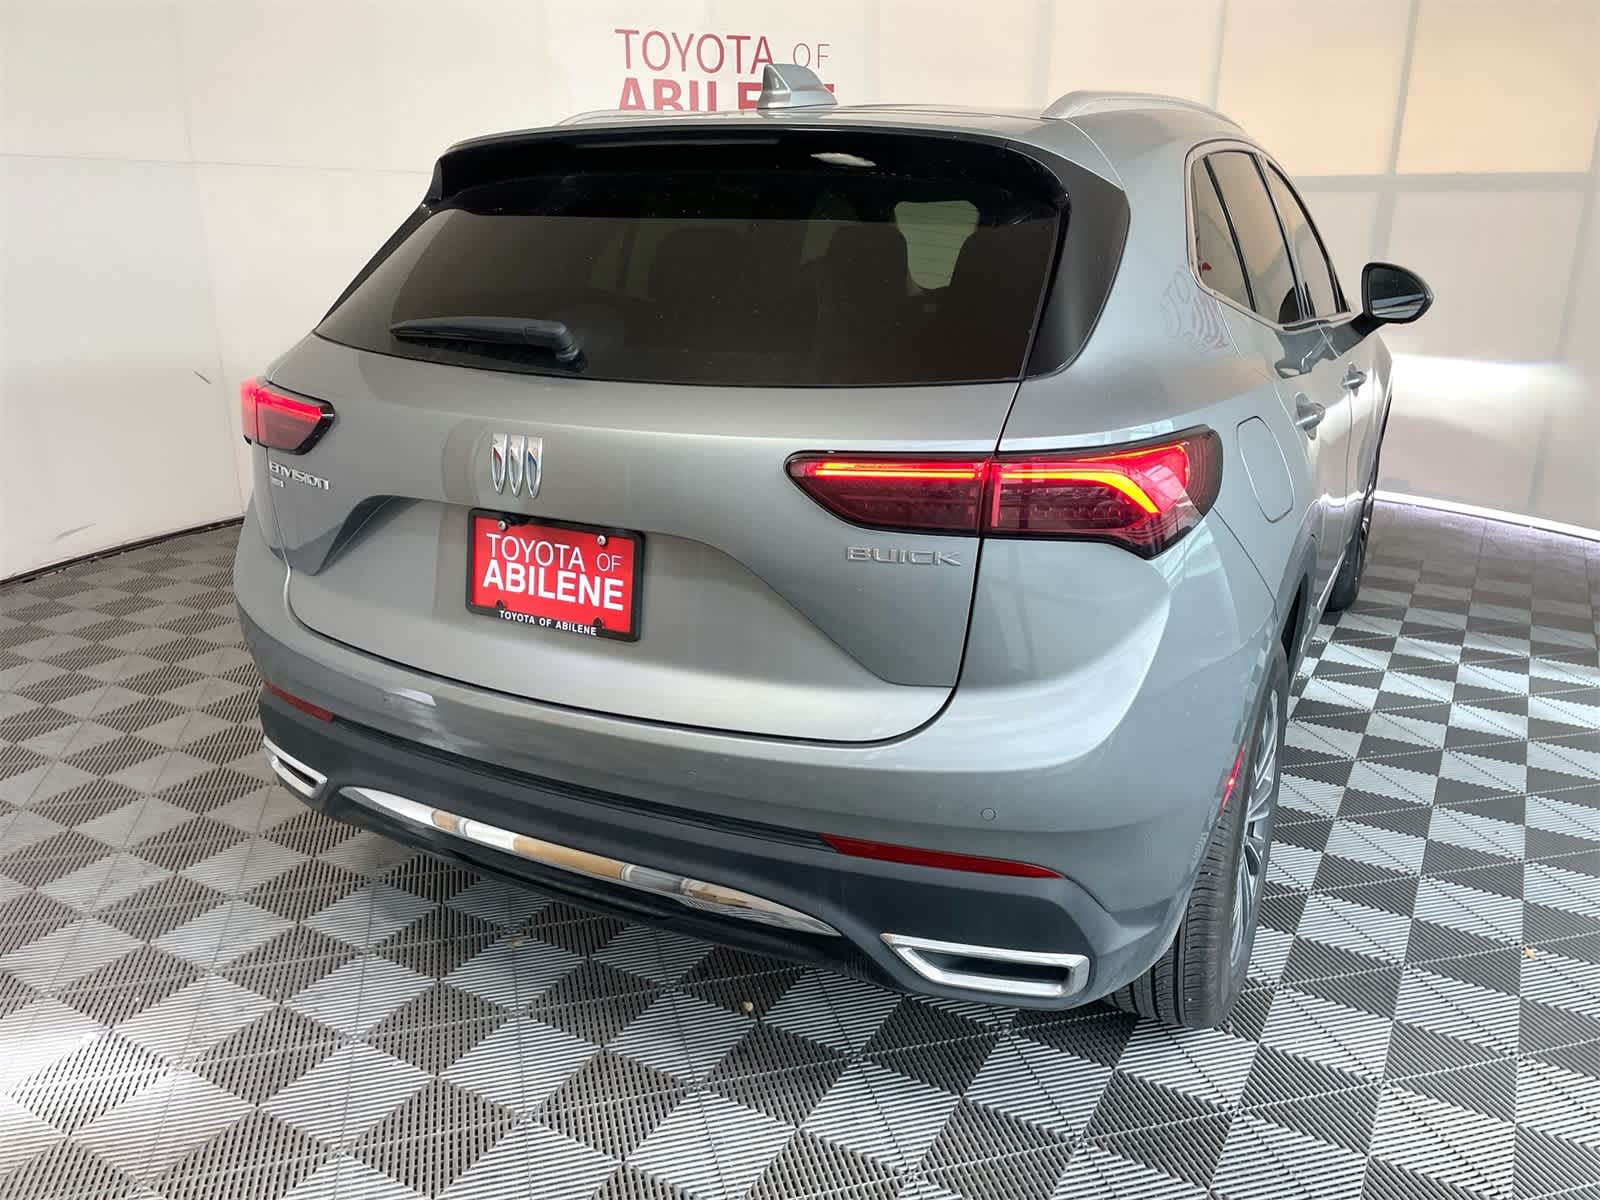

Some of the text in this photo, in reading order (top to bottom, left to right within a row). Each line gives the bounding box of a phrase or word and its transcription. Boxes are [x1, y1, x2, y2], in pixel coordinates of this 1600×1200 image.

[614, 28, 830, 74] TOYOTA OF
[618, 77, 835, 112] ABIE
[486, 532, 623, 573] TOYOTA OF
[847, 546, 961, 566] BUICK
[482, 559, 624, 611] ABILENE
[499, 610, 597, 636] TOYOTA OF ABILENE
